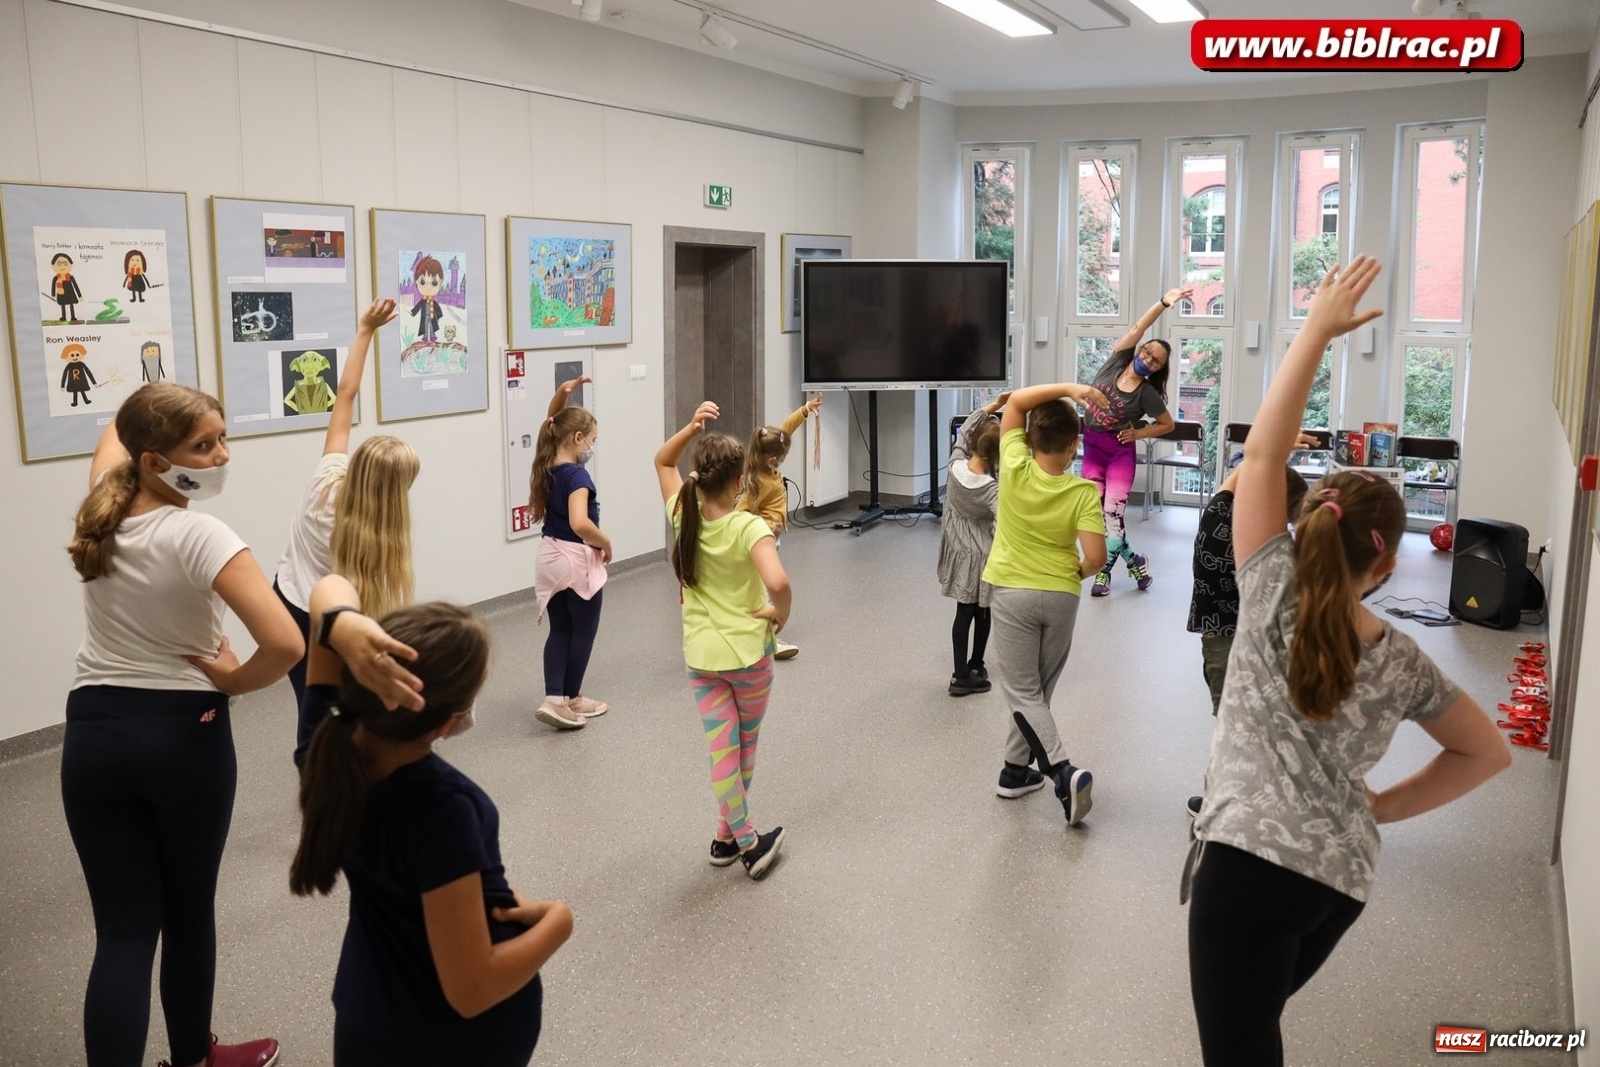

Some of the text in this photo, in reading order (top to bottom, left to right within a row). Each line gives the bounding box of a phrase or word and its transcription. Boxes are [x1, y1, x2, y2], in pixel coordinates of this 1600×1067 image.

[41, 242, 56, 250] Harry
[57, 241, 72, 249] Potter
[78, 243, 104, 251] komnata
[79, 252, 104, 262] tajemnic
[46, 335, 102, 344] Ron Weasley
[72, 369, 80, 380] R
[200, 709, 216, 722] 4F
